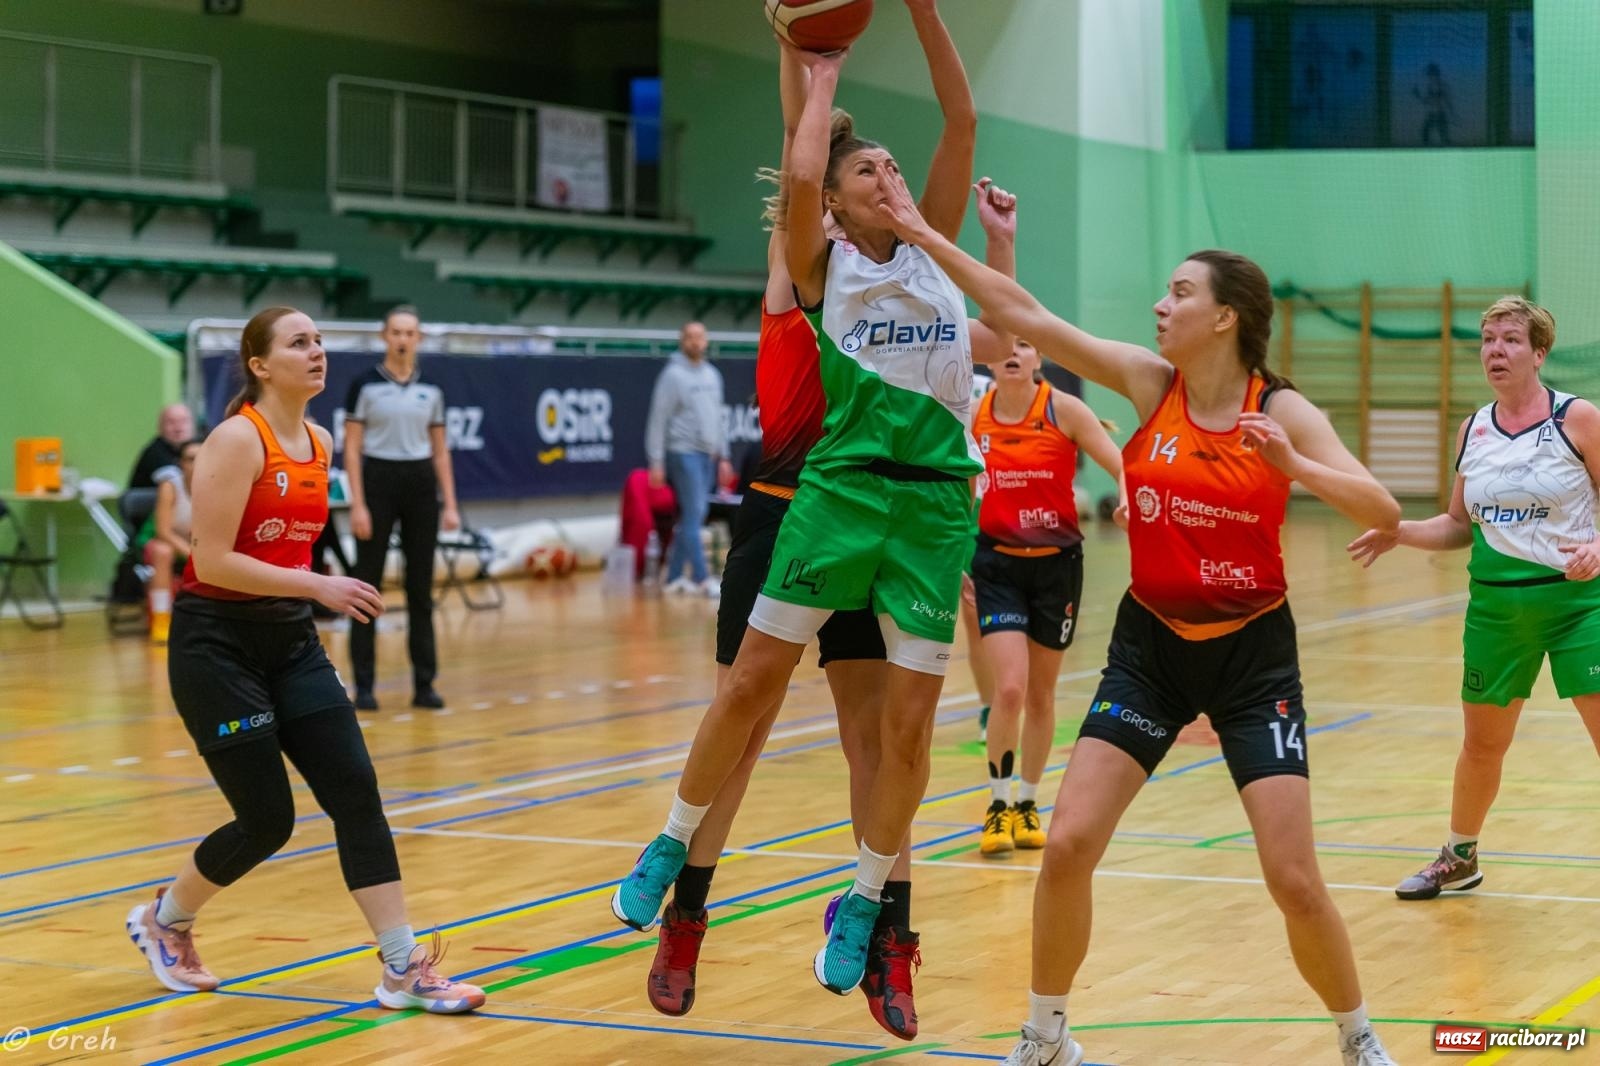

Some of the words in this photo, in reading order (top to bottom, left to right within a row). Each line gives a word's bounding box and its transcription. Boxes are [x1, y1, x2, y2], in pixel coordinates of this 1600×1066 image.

[868, 317, 956, 346] Clavis
[981, 433, 991, 454] 8
[1149, 432, 1179, 464] 14
[275, 471, 289, 497] 9
[995, 469, 1054, 480] Politechnika
[1170, 496, 1260, 524] Politechnika
[1170, 510, 1217, 529] Śląska
[1481, 503, 1551, 523] Clavis
[781, 559, 827, 595] 14
[1060, 618, 1073, 644] 8
[1269, 721, 1304, 761] 14
